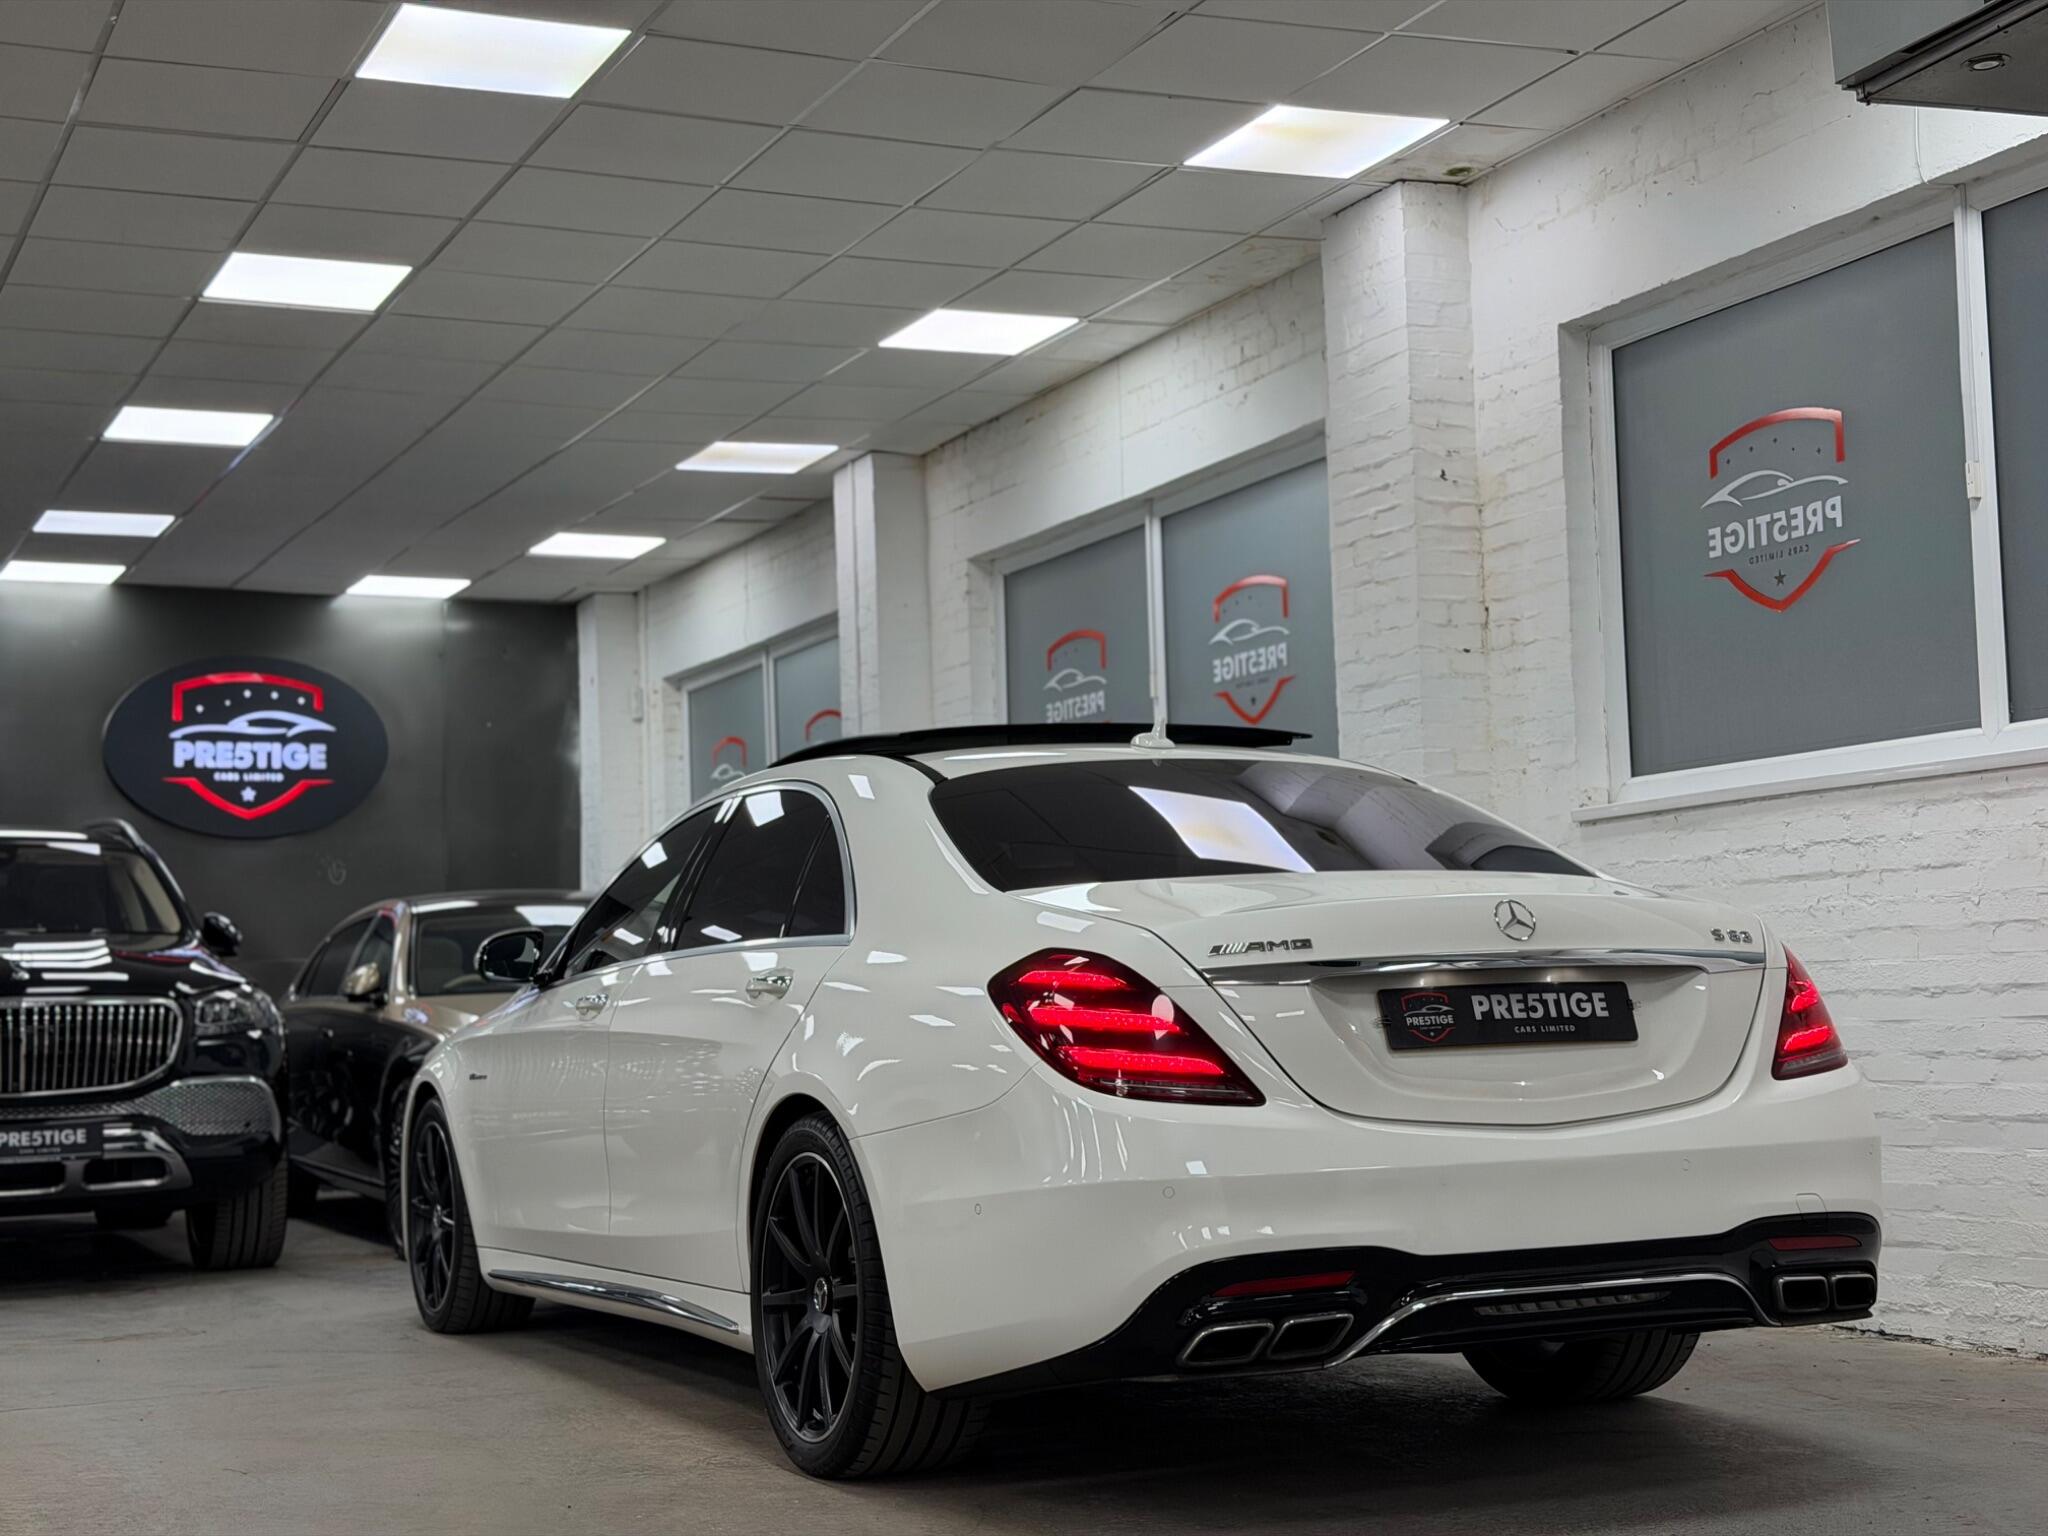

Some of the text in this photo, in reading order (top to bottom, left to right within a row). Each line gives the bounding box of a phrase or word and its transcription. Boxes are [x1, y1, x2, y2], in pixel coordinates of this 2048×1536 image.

[1243, 938, 1313, 953] AMG
[1514, 1023, 1577, 1034] CARS LIMITED
